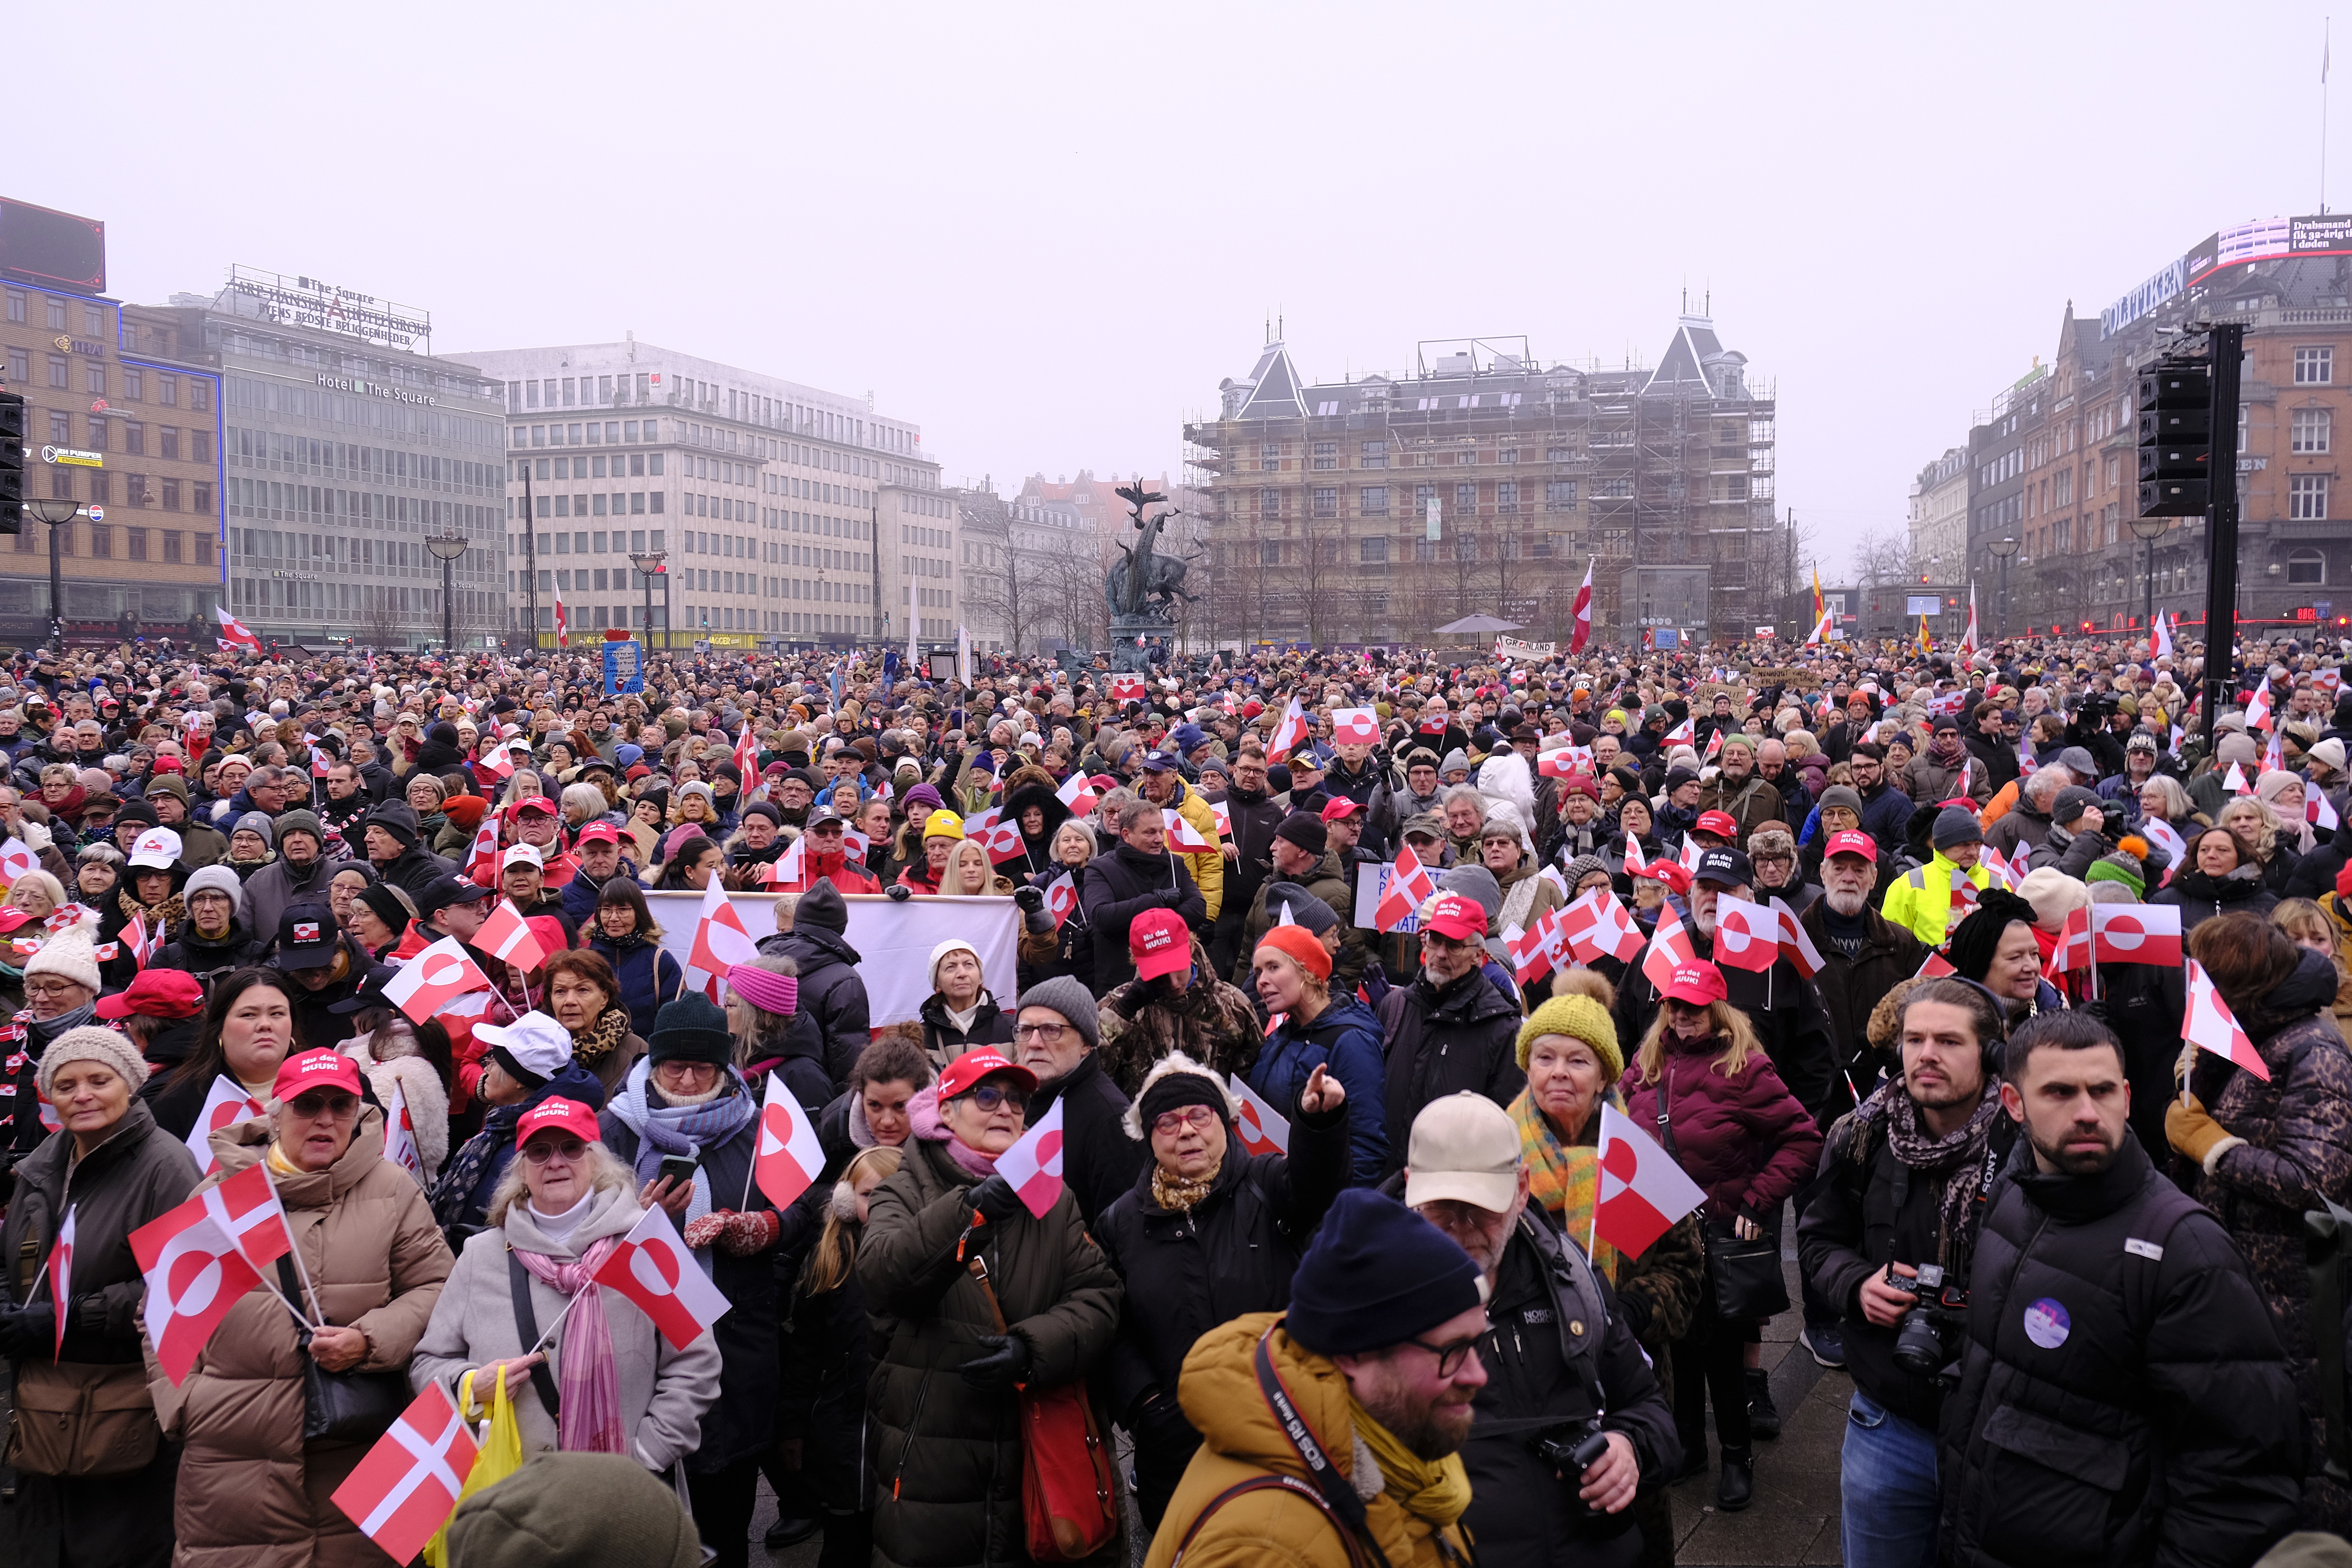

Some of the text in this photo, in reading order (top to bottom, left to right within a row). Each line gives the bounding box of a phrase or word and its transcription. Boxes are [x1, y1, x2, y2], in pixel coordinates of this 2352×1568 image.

[2294, 219, 2351, 230] Drabsmand
[2293, 230, 2307, 239] fik
[2298, 239, 2330, 249] døden
[309, 279, 374, 304] The Square
[2100, 255, 2188, 341] POLITIKEN
[295, 311, 332, 328] BEDSTE
[336, 320, 410, 345] BELIGGENHEDER
[316, 373, 436, 406] Hotel The Square
[70, 449, 102, 459] PUMPER
[62, 458, 98, 466] ENGINEERING
[295, 571, 318, 580] Square
[1841, 838, 1864, 846] NUUK!
[1720, 854, 1733, 863] det
[1707, 860, 1731, 869] NUUK!
[1449, 902, 1461, 911] det
[1155, 929, 1169, 937] det
[1146, 936, 1171, 949] NUUK!
[1687, 969, 1700, 978] det
[1674, 976, 1699, 985] NUUK!
[302, 1054, 337, 1066] Nu det
[302, 1063, 338, 1073] NUUK!
[536, 1104, 549, 1113] Nu
[534, 1110, 569, 1119] NUUK!
[1981, 1149, 1998, 1194] SONY
[1276, 1398, 1295, 1421] Mark
[1298, 1436, 1326, 1472] EOS
